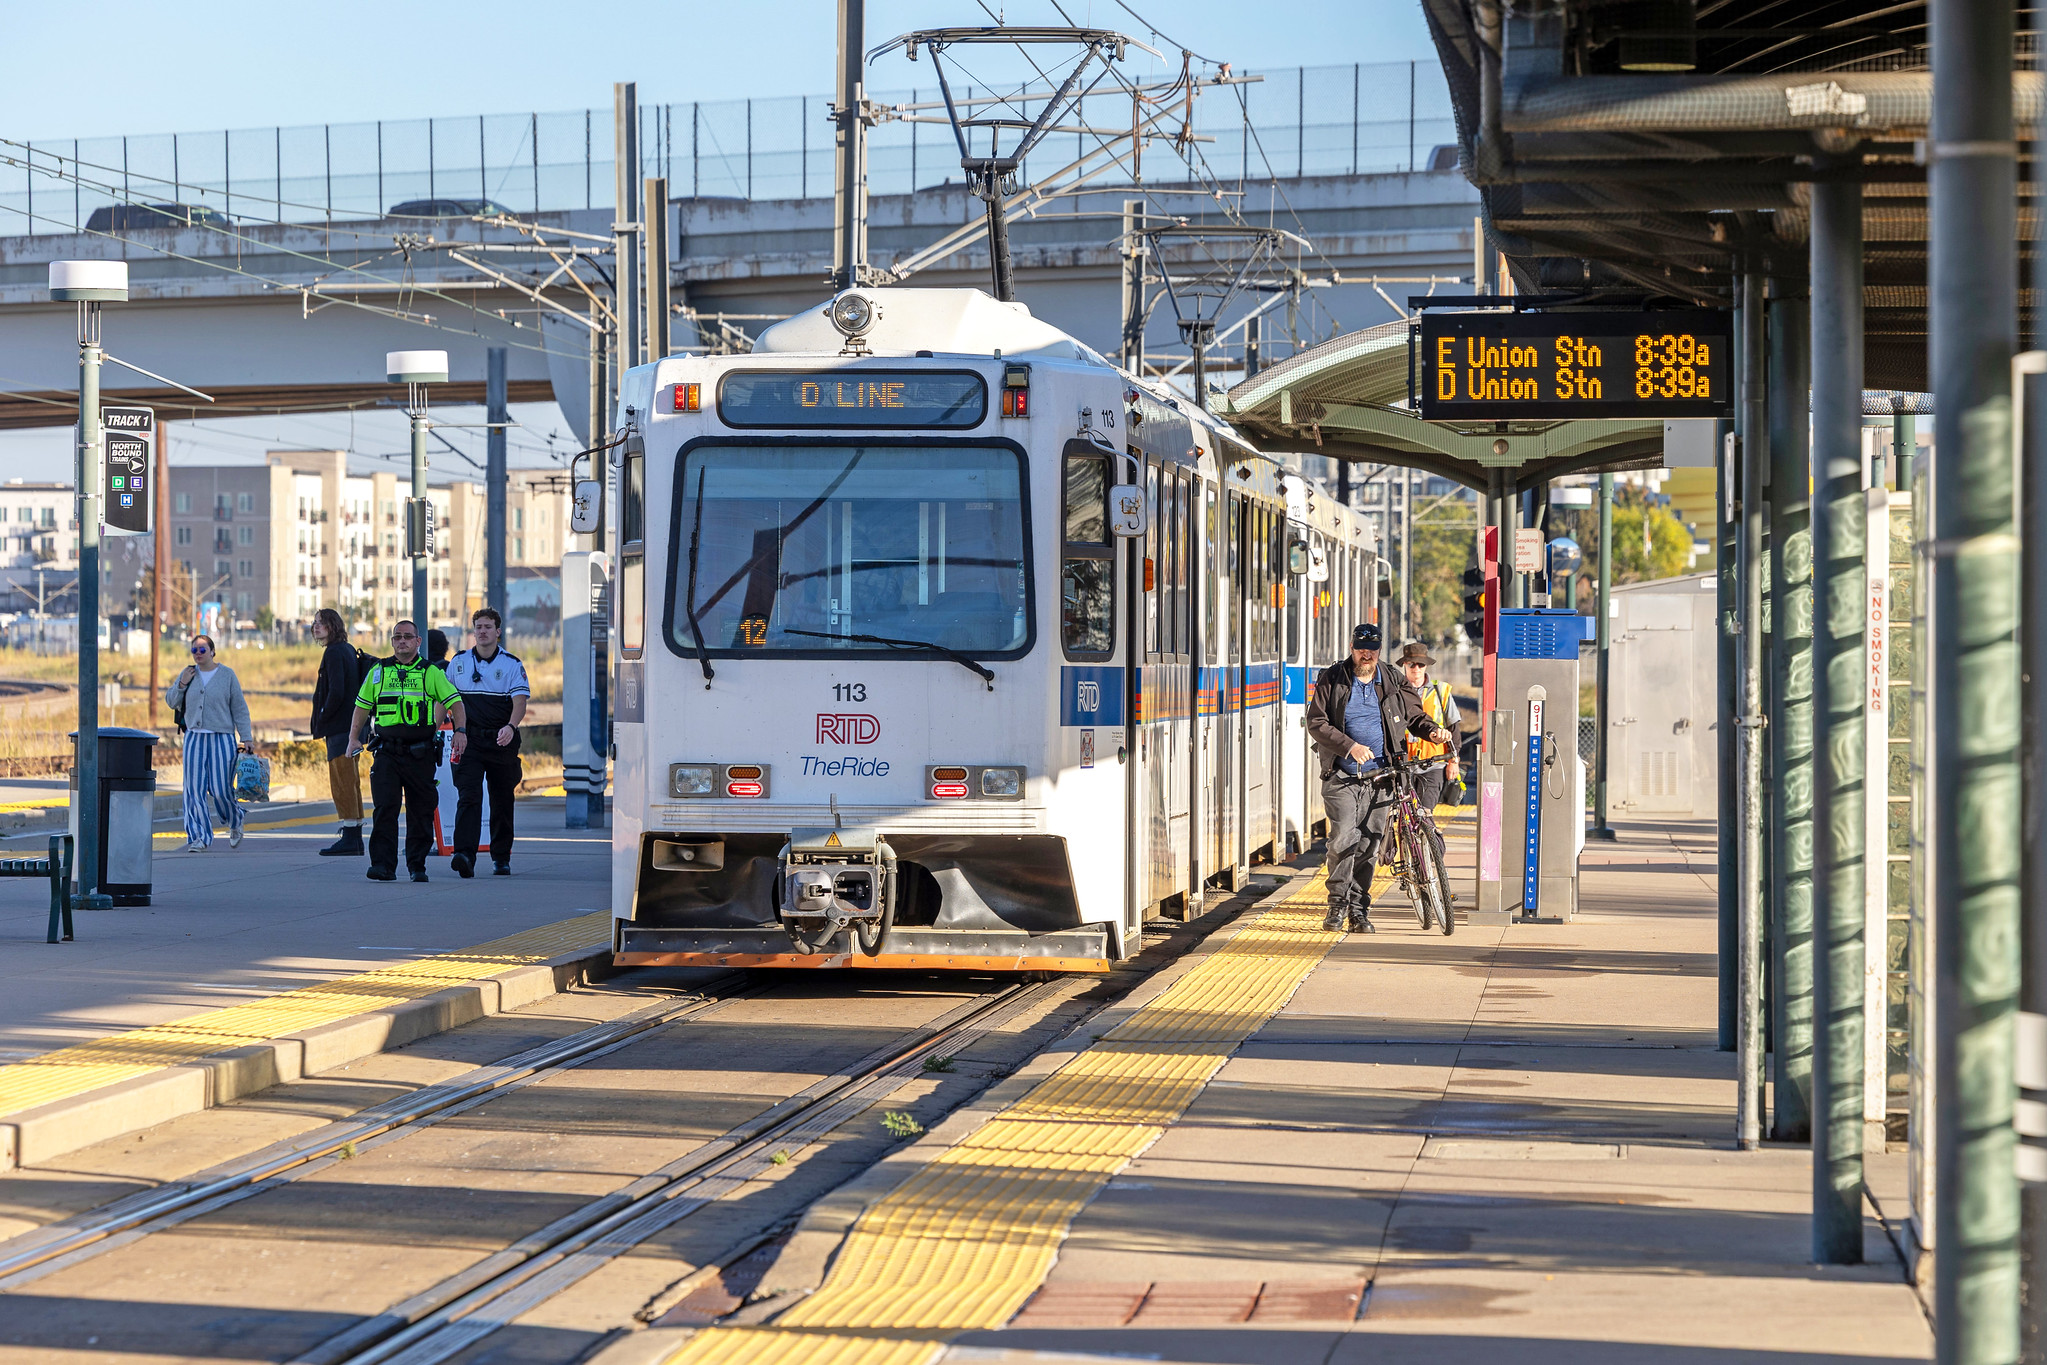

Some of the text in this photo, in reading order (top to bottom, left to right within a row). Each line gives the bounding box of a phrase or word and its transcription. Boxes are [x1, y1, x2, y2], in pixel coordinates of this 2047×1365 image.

[1438, 334, 1710, 368] E Union Stn 8:39a
[802, 382, 904, 407] D LINE
[1438, 367, 1710, 400] D Union Stn 8:39a
[108, 415, 149, 426] TRACK 1
[1102, 410, 1114, 428] 113
[740, 620, 766, 644] 12
[1872, 597, 1882, 710] NO SMOKING
[832, 683, 866, 702] 113
[1078, 681, 1100, 712] RTD
[816, 713, 881, 744] RTD
[800, 756, 889, 776] TheRide
